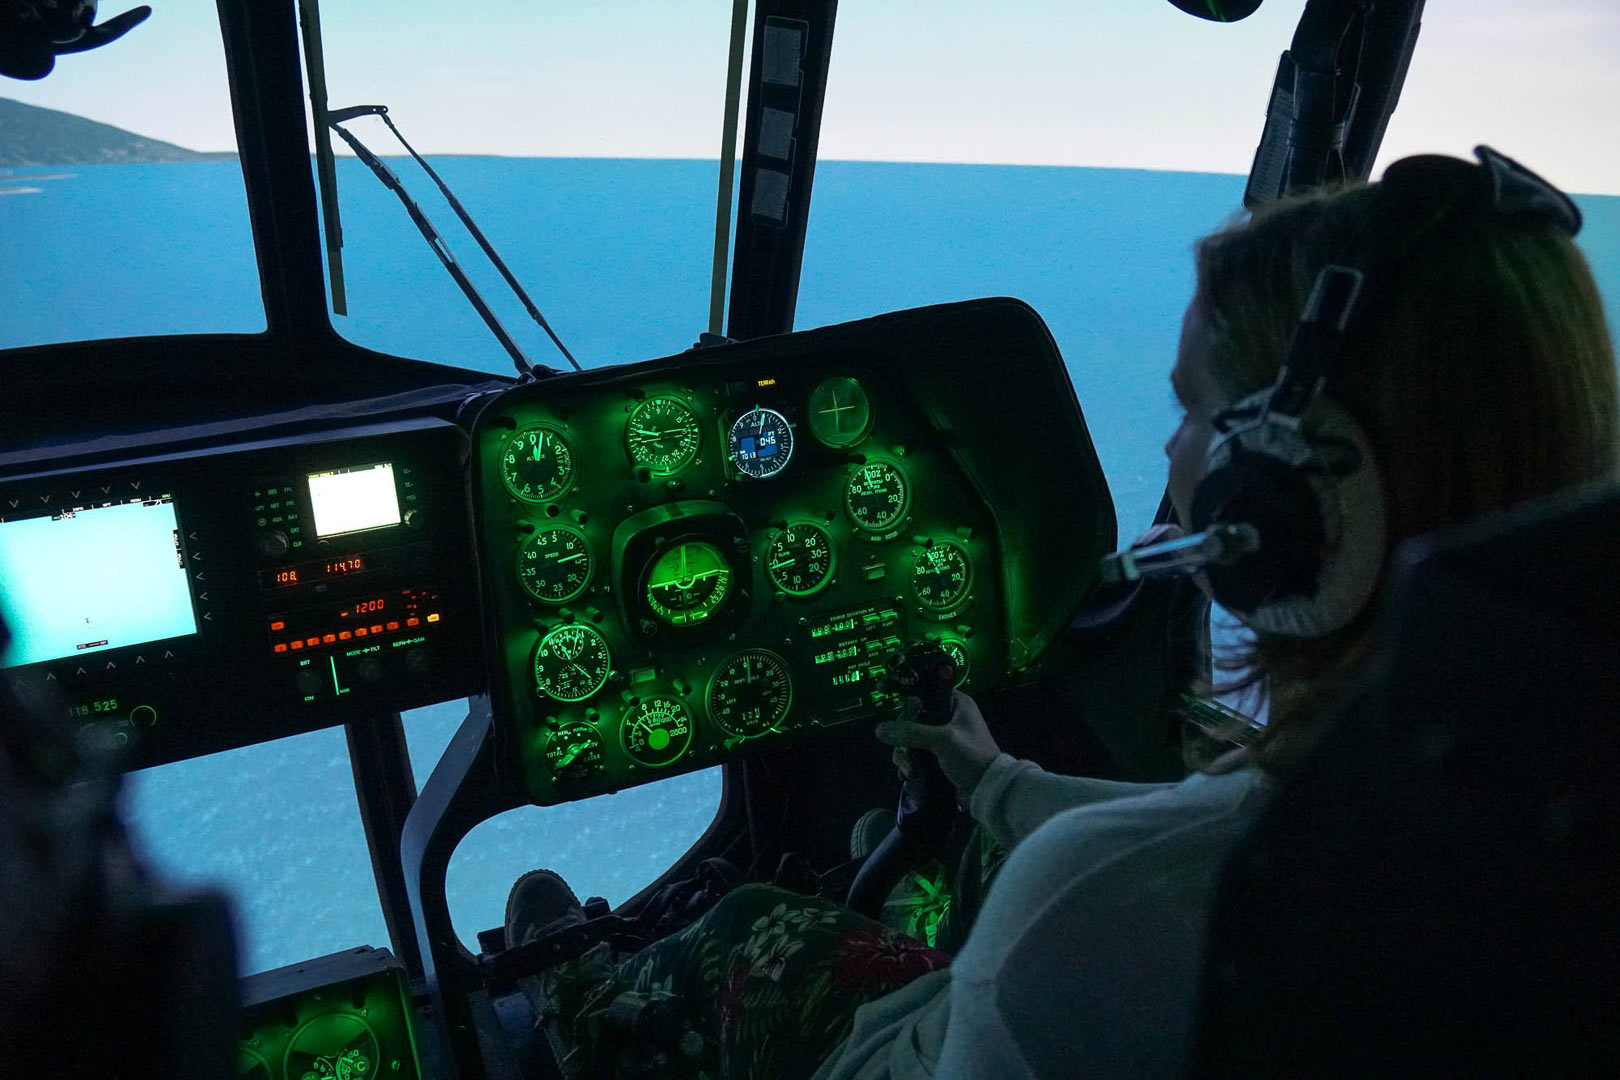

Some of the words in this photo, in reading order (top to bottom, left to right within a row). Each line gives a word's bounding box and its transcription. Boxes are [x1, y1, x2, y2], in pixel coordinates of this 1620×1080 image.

[530, 434, 536, 445] 0
[517, 441, 524, 450] 9
[555, 445, 561, 454] 2
[509, 455, 515, 464] 8
[511, 472, 517, 482] 7
[550, 477, 556, 485] 4
[885, 473, 890, 482] 0
[524, 483, 530, 493] 6
[538, 484, 544, 494] 5
[852, 485, 862, 494] 80
[888, 494, 898, 503] 20
[857, 507, 867, 516] 60
[876, 511, 887, 519] 40
[537, 537, 547, 545] 45
[787, 534, 795, 543] 10
[805, 538, 816, 547] 20
[566, 542, 574, 550] 10
[777, 542, 783, 552] 5
[811, 549, 822, 558] 30
[809, 562, 819, 572] 20
[917, 566, 925, 574] 80
[526, 568, 536, 576] 35
[782, 572, 788, 581] 5
[951, 572, 960, 581] 20
[567, 573, 577, 582] 20
[793, 575, 801, 584] 10
[536, 580, 546, 588] 30
[553, 583, 563, 592] 25
[923, 587, 931, 595] 60
[355, 599, 384, 614] 1200
[541, 649, 548, 657] 10
[671, 704, 681, 713] 20
